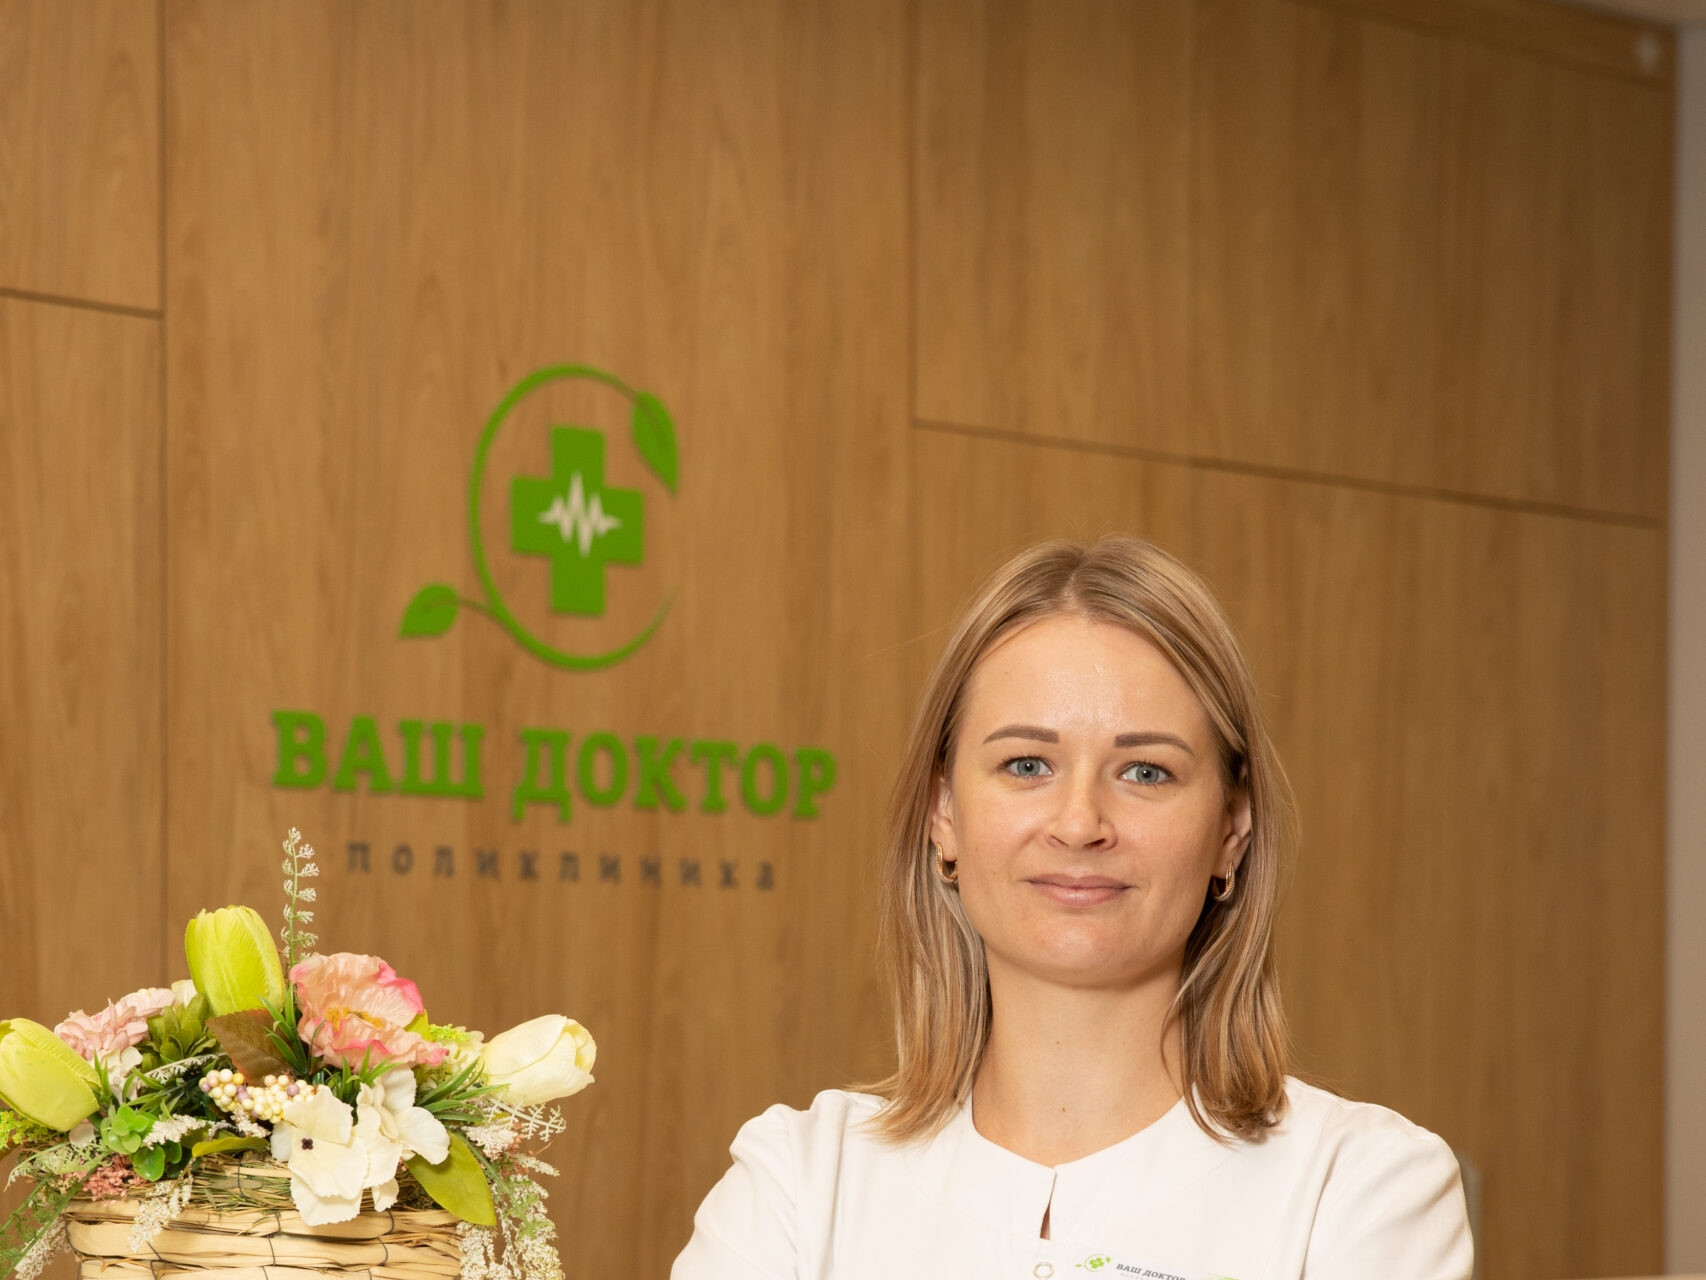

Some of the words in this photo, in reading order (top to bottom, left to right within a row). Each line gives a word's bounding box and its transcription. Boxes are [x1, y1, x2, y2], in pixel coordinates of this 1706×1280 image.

[272, 709, 486, 799] ВАШ
[511, 727, 838, 825] ДОКТОР
[1116, 1263, 1141, 1275] ВАШ
